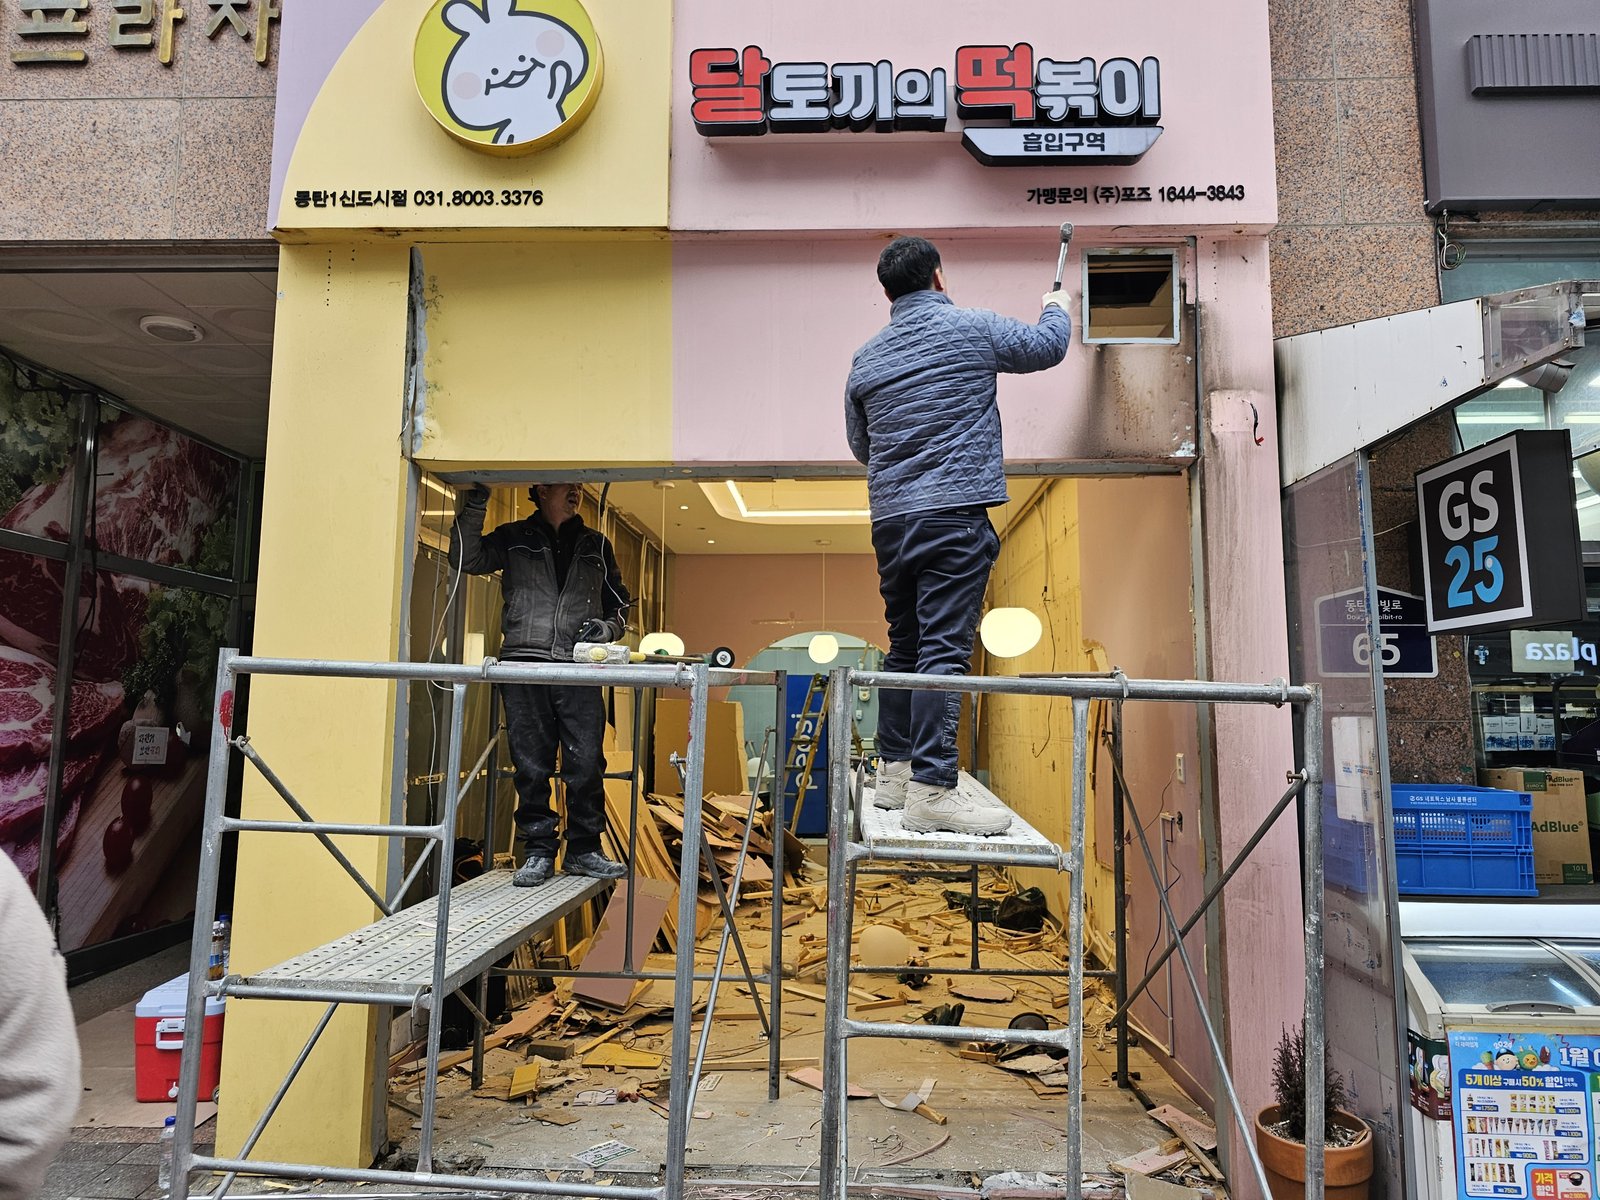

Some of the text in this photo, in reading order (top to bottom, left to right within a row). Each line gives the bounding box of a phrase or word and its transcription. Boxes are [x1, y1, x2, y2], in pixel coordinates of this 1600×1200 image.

[690, 42, 1161, 130] 달토끼의 떡볶이
[1023, 132, 1106, 152] 흡입구역
[294, 190, 544, 208] 동탄1신도시점 031.8003.3376
[1027, 184, 1246, 204] 가맹문의 (주)포즈 1644-3843
[1438, 470, 1499, 541] GS
[1444, 535, 1504, 608] 25
[1353, 633, 1401, 666] 65
[1531, 820, 1579, 833] AdBlue
[1559, 1047, 1590, 1068] 1월
[1465, 1073, 1482, 1086] 5개
[1484, 1074, 1502, 1087] 이상
[1522, 1075, 1544, 1087] 50%
[1545, 1076, 1564, 1088] 할인
[1534, 1172, 1554, 1184] 가격
[1536, 1185, 1555, 1197] 할인
